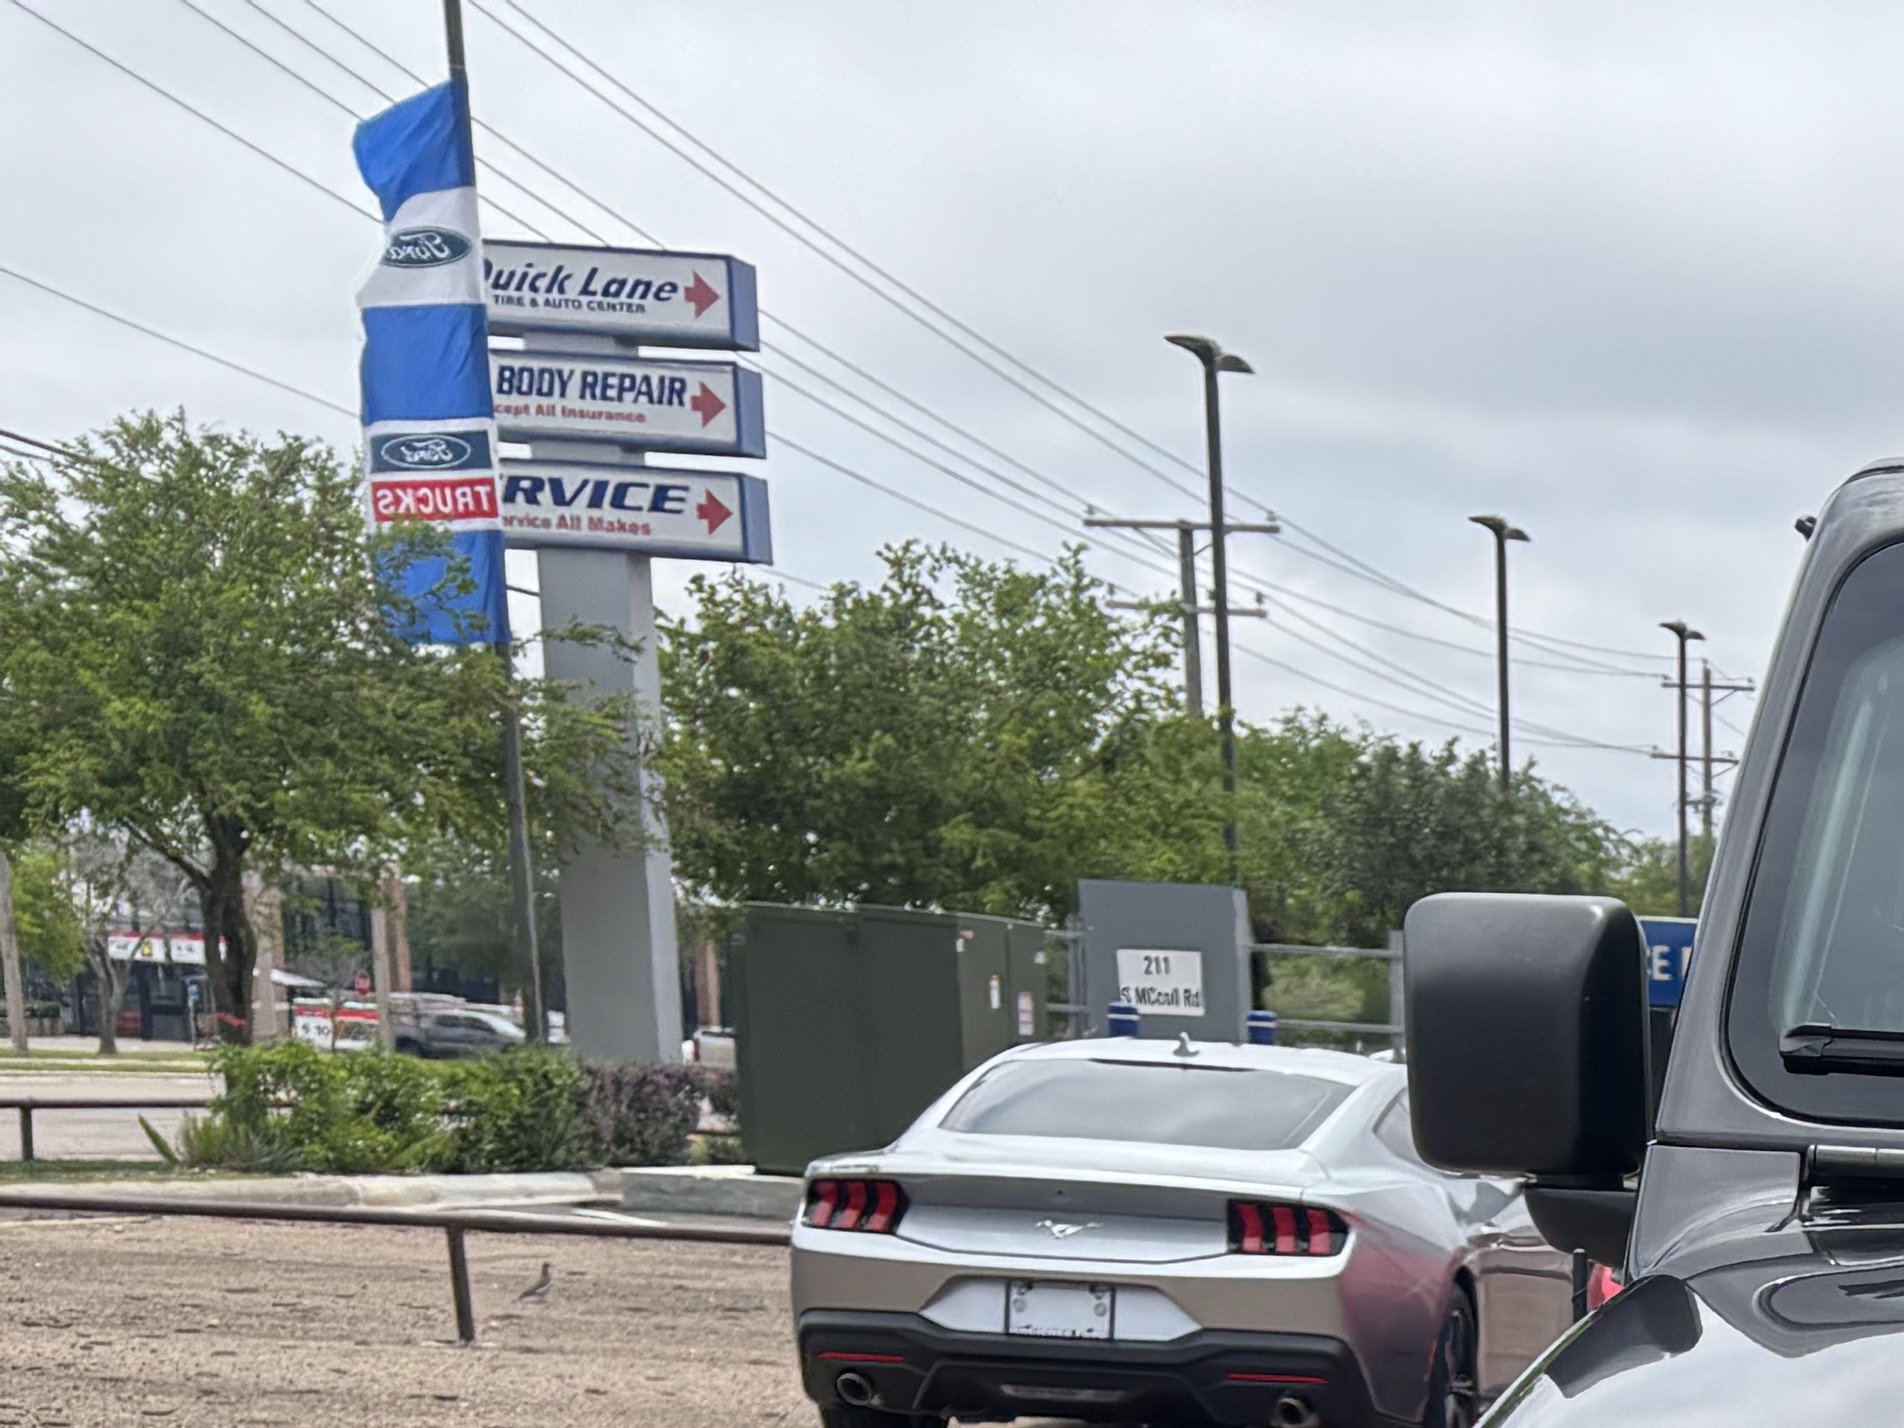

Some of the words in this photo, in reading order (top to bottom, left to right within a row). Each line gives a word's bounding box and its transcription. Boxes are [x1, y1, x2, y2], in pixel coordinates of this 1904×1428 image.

[578, 267, 679, 302] Lane
[491, 294, 526, 307] TIRE
[543, 298, 582, 310] AUTO
[586, 300, 646, 314] CENTER
[496, 364, 575, 399] BODY
[578, 370, 688, 408] REPAIR
[494, 404, 530, 418] cept
[535, 404, 556, 417] All
[561, 405, 646, 424] Insurance
[500, 473, 691, 515] RVICE
[556, 514, 582, 531] All
[587, 515, 652, 537] Makes
[1143, 955, 1170, 976] 211
